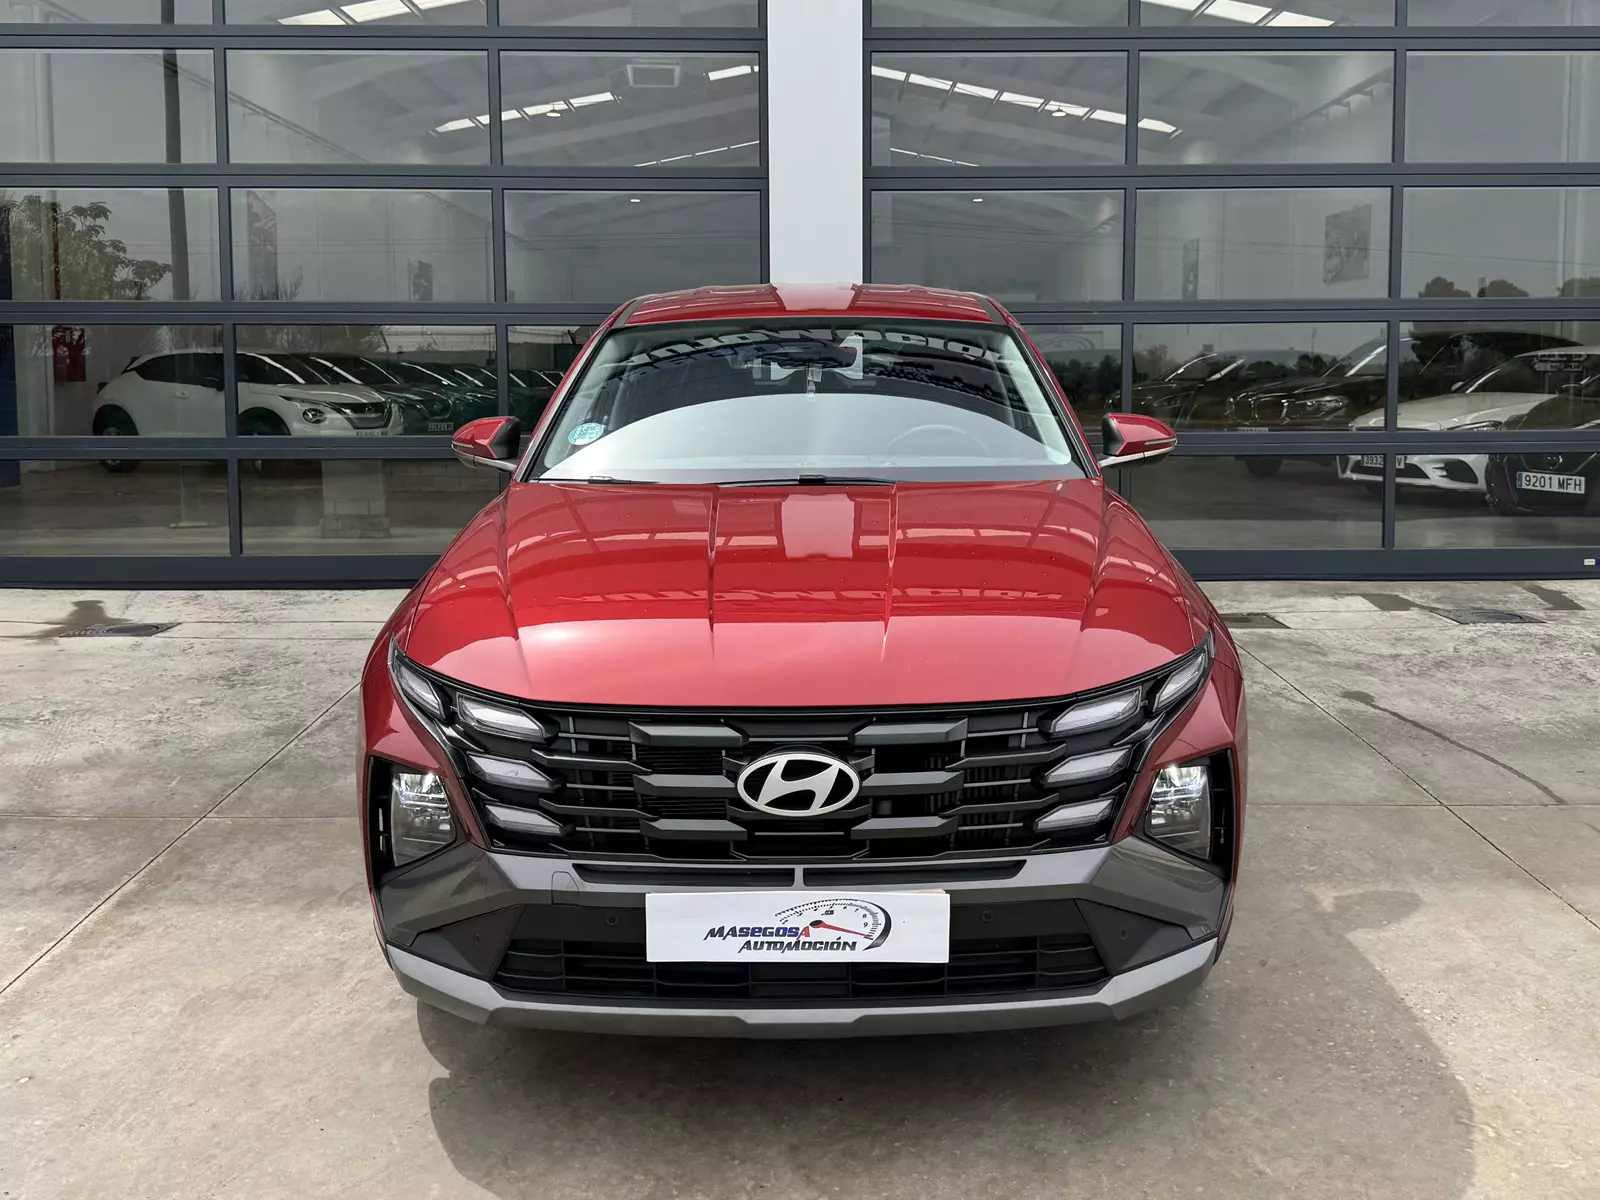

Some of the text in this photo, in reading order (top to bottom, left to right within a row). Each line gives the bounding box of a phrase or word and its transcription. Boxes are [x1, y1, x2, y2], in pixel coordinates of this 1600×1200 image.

[1524, 474, 1582, 492] 9201 MFH
[737, 936, 858, 953] AUTOMOCIÓN
